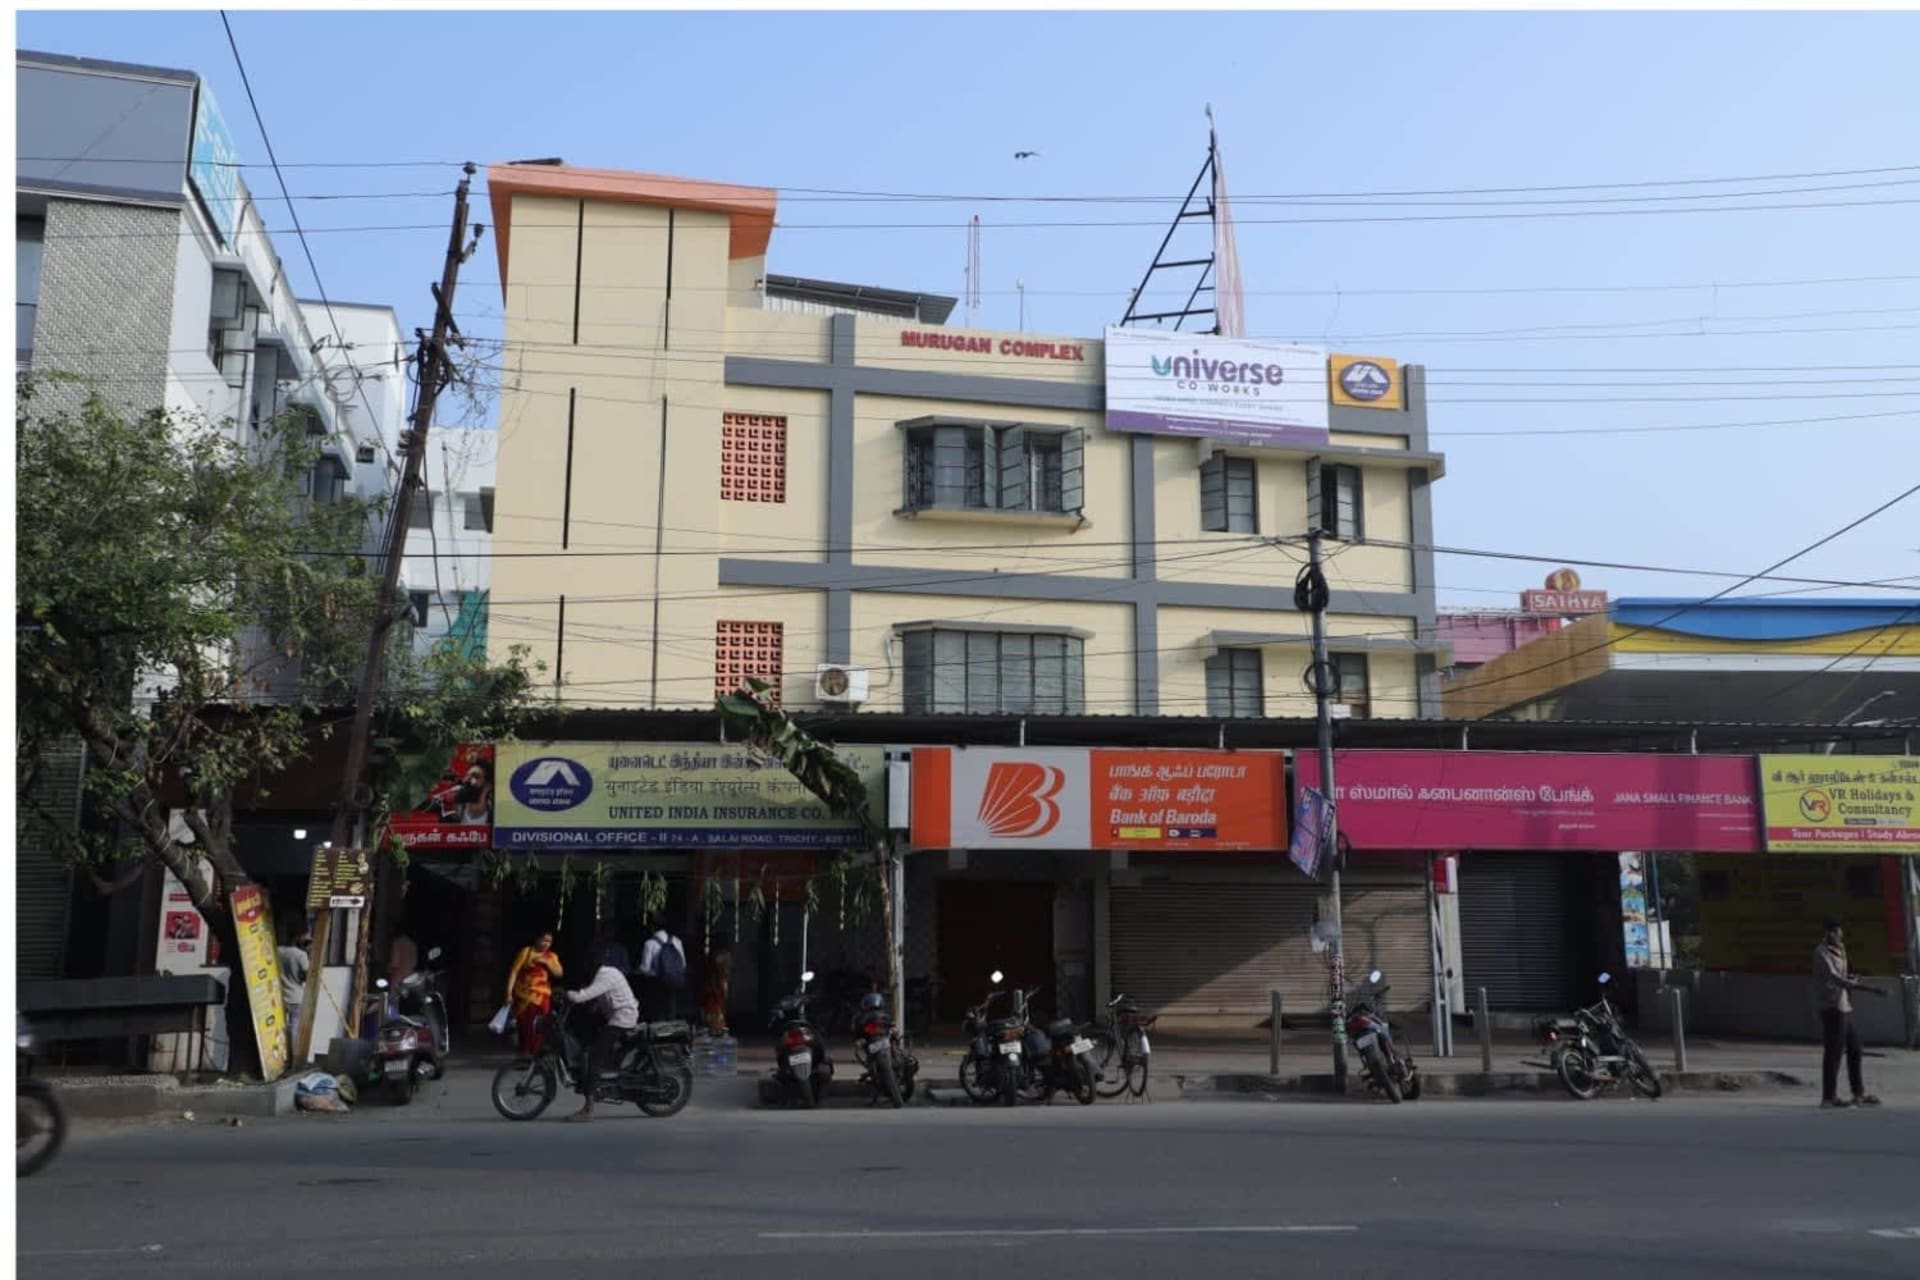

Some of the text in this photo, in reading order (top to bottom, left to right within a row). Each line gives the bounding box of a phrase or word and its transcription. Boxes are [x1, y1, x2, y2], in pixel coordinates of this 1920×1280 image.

[901, 331, 1084, 361] MURUGAN COMPLEX
[1208, 383, 1261, 397] WORKS
[1614, 792, 1754, 805] JANA SMALL FINANCE BANK
[1829, 788, 1846, 800] VR
[1850, 788, 1901, 803] Holidays
[608, 805, 664, 820] UNITED
[668, 806, 709, 820] INDIA
[713, 806, 796, 820] INSURANCE
[1110, 809, 1217, 825] Bank of Baroda
[1838, 802, 1913, 818] Consultancy
[512, 831, 592, 844] DIVISIONAL
[596, 831, 647, 844] OFFICE
